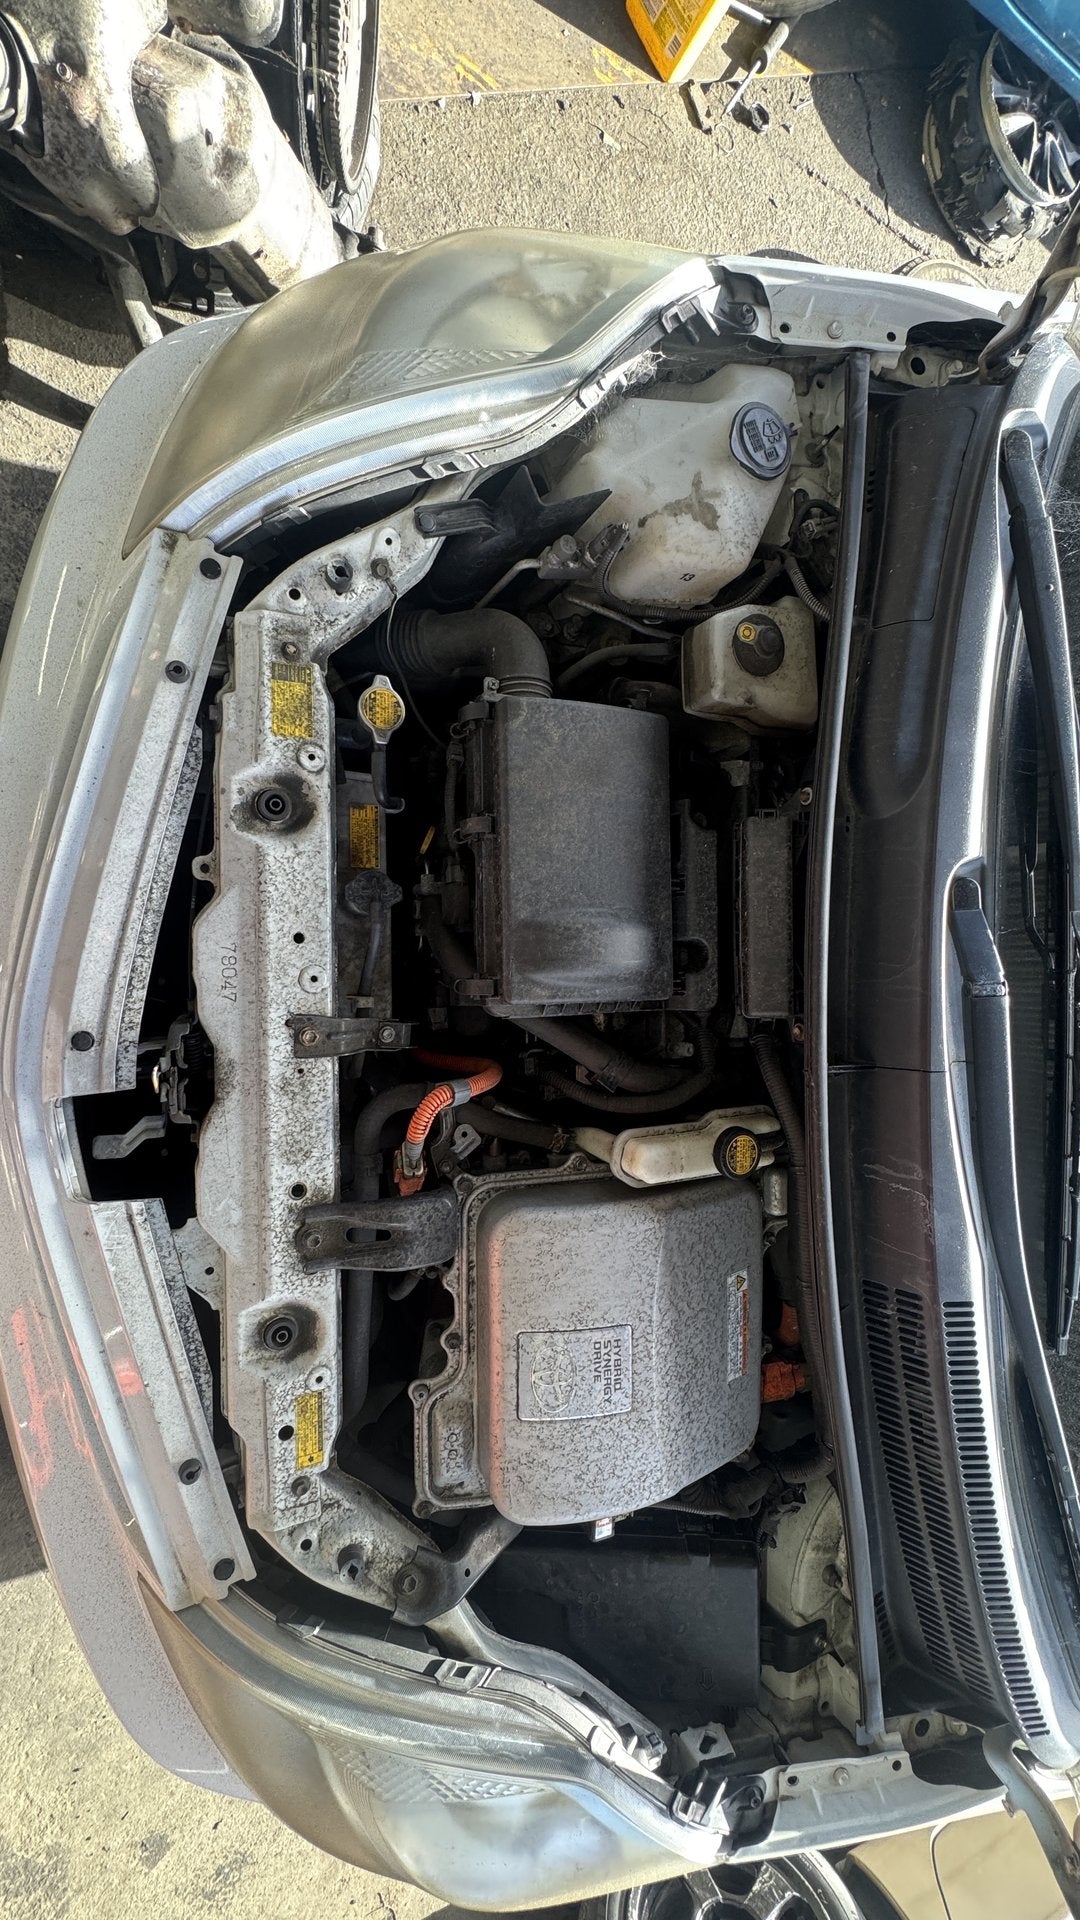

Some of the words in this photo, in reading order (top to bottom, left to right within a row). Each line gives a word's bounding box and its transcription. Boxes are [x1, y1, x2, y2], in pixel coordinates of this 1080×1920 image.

[220, 942, 238, 1003] 78047
[593, 1341, 602, 1383] DRIVE
[603, 1339, 613, 1404] SYNERGY
[613, 1338, 623, 1391] HYBRID
